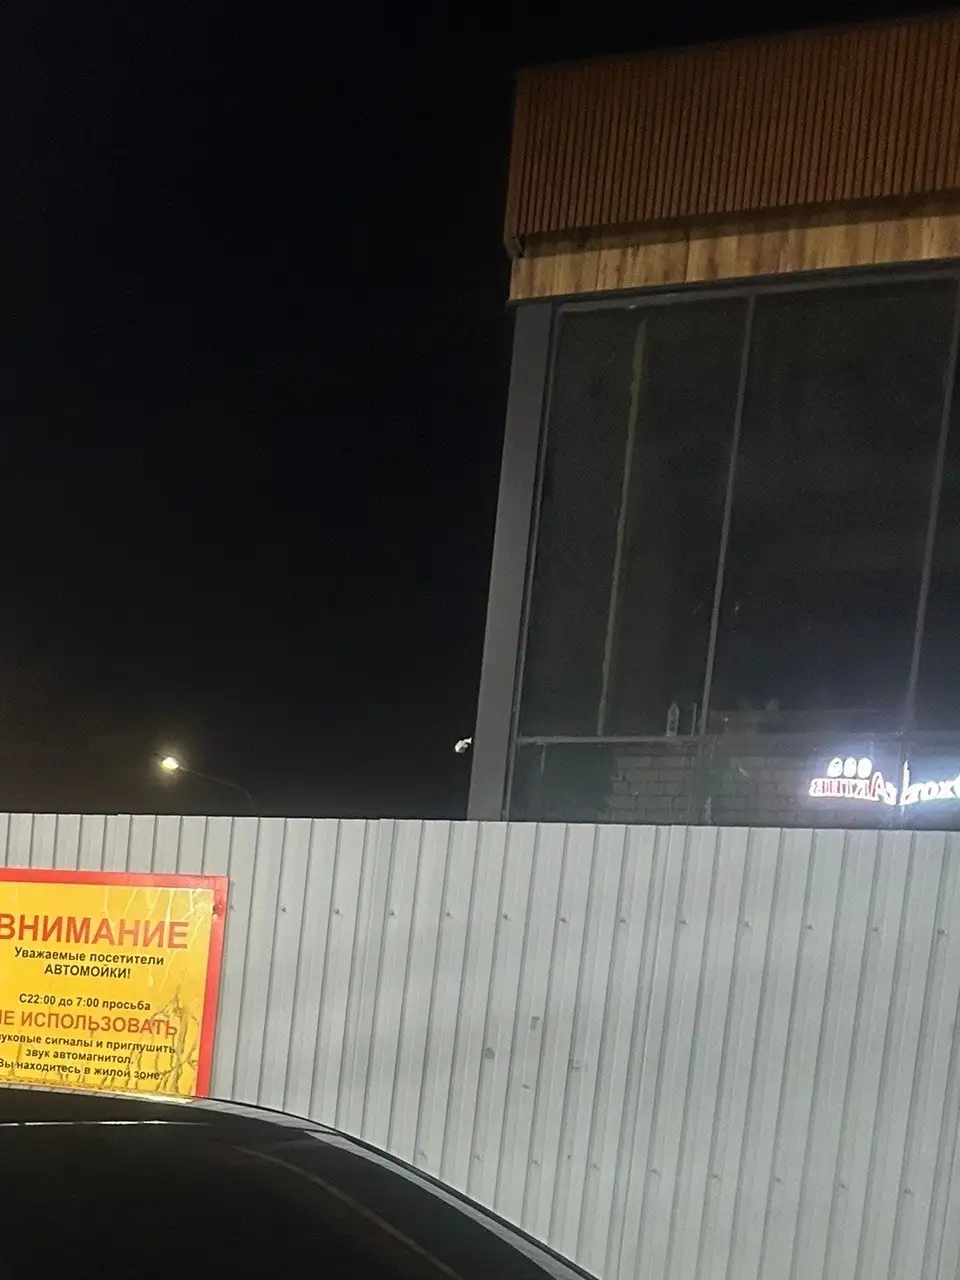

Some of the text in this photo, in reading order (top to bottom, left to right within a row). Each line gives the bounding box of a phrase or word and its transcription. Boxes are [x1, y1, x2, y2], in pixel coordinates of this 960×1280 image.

[14, 946, 165, 966] Уважаемые посетители
[44, 963, 132, 979] АВТОМОЙКИ!
[19, 993, 151, 1012] С22:00 до 7:00 просьба
[20, 1011, 178, 1037] ИСПОЛЬЗОВАТЬ
[44, 1036, 93, 1048] сигналы
[96, 1040, 103, 1049] и
[106, 1042, 176, 1055] приглушить
[25, 1048, 134, 1065] звук автомагнитол.
[16, 1061, 81, 1075] находитесь
[84, 1066, 91, 1075] в
[93, 1065, 131, 1079] жилой
